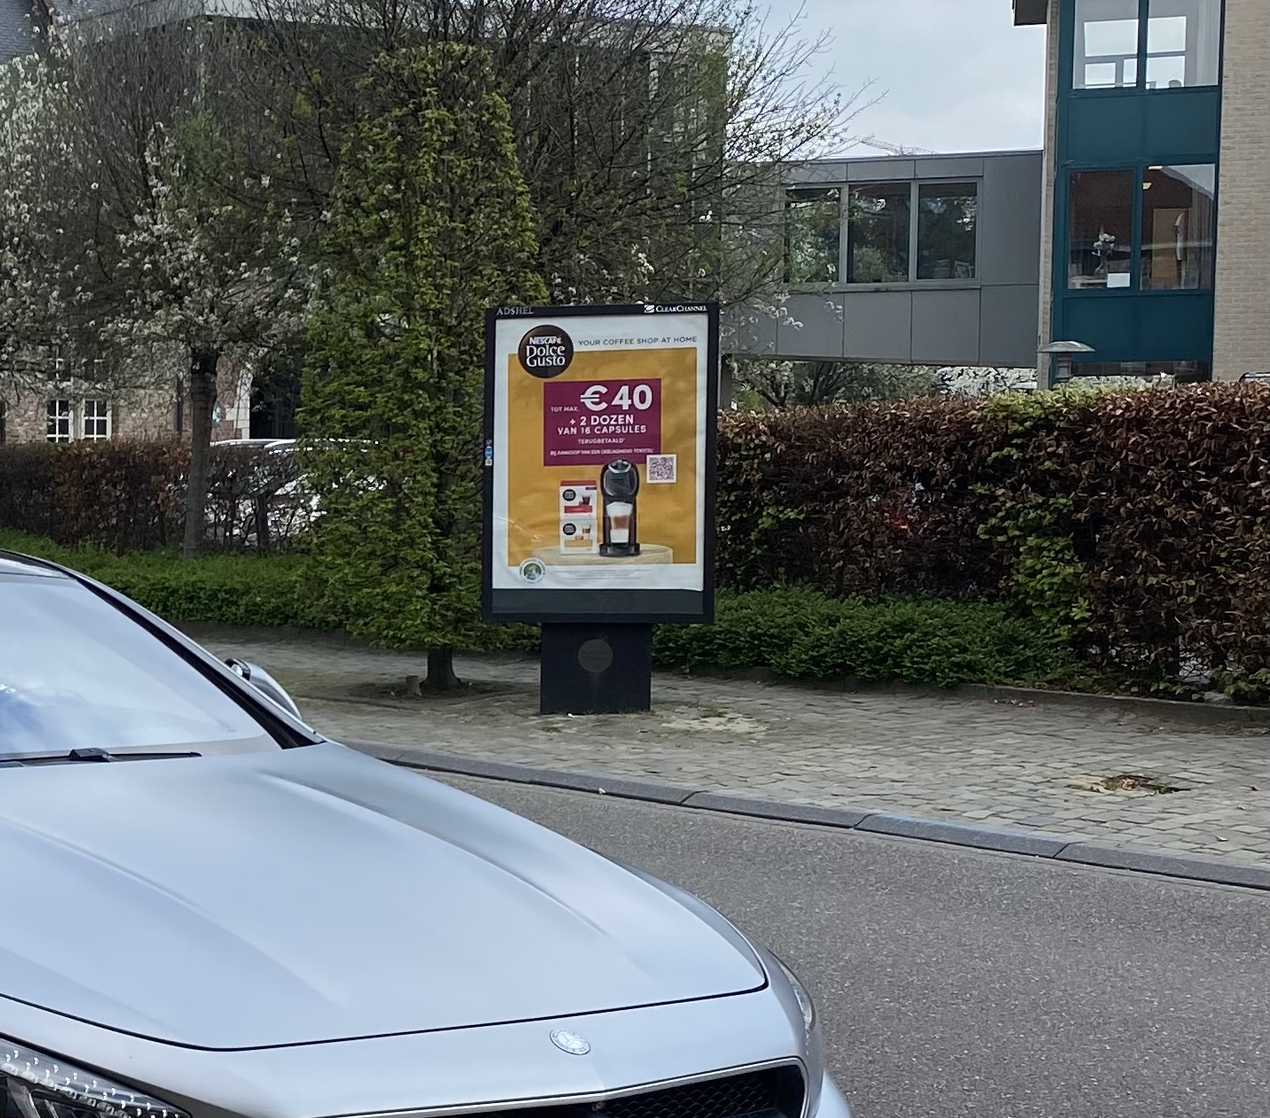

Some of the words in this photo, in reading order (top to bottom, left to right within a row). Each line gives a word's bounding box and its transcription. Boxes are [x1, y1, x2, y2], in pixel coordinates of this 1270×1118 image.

[496, 306, 535, 316] ADSHEL
[603, 338, 634, 346] COFFEE
[636, 337, 659, 345] SHOP
[526, 345, 566, 357] Dolce
[526, 354, 566, 367] Gusto
[579, 416, 587, 426] 2
[590, 414, 634, 425] DOZEN
[557, 427, 577, 435] VAN
[581, 427, 591, 435] 16
[594, 425, 647, 434] CAPSULES
